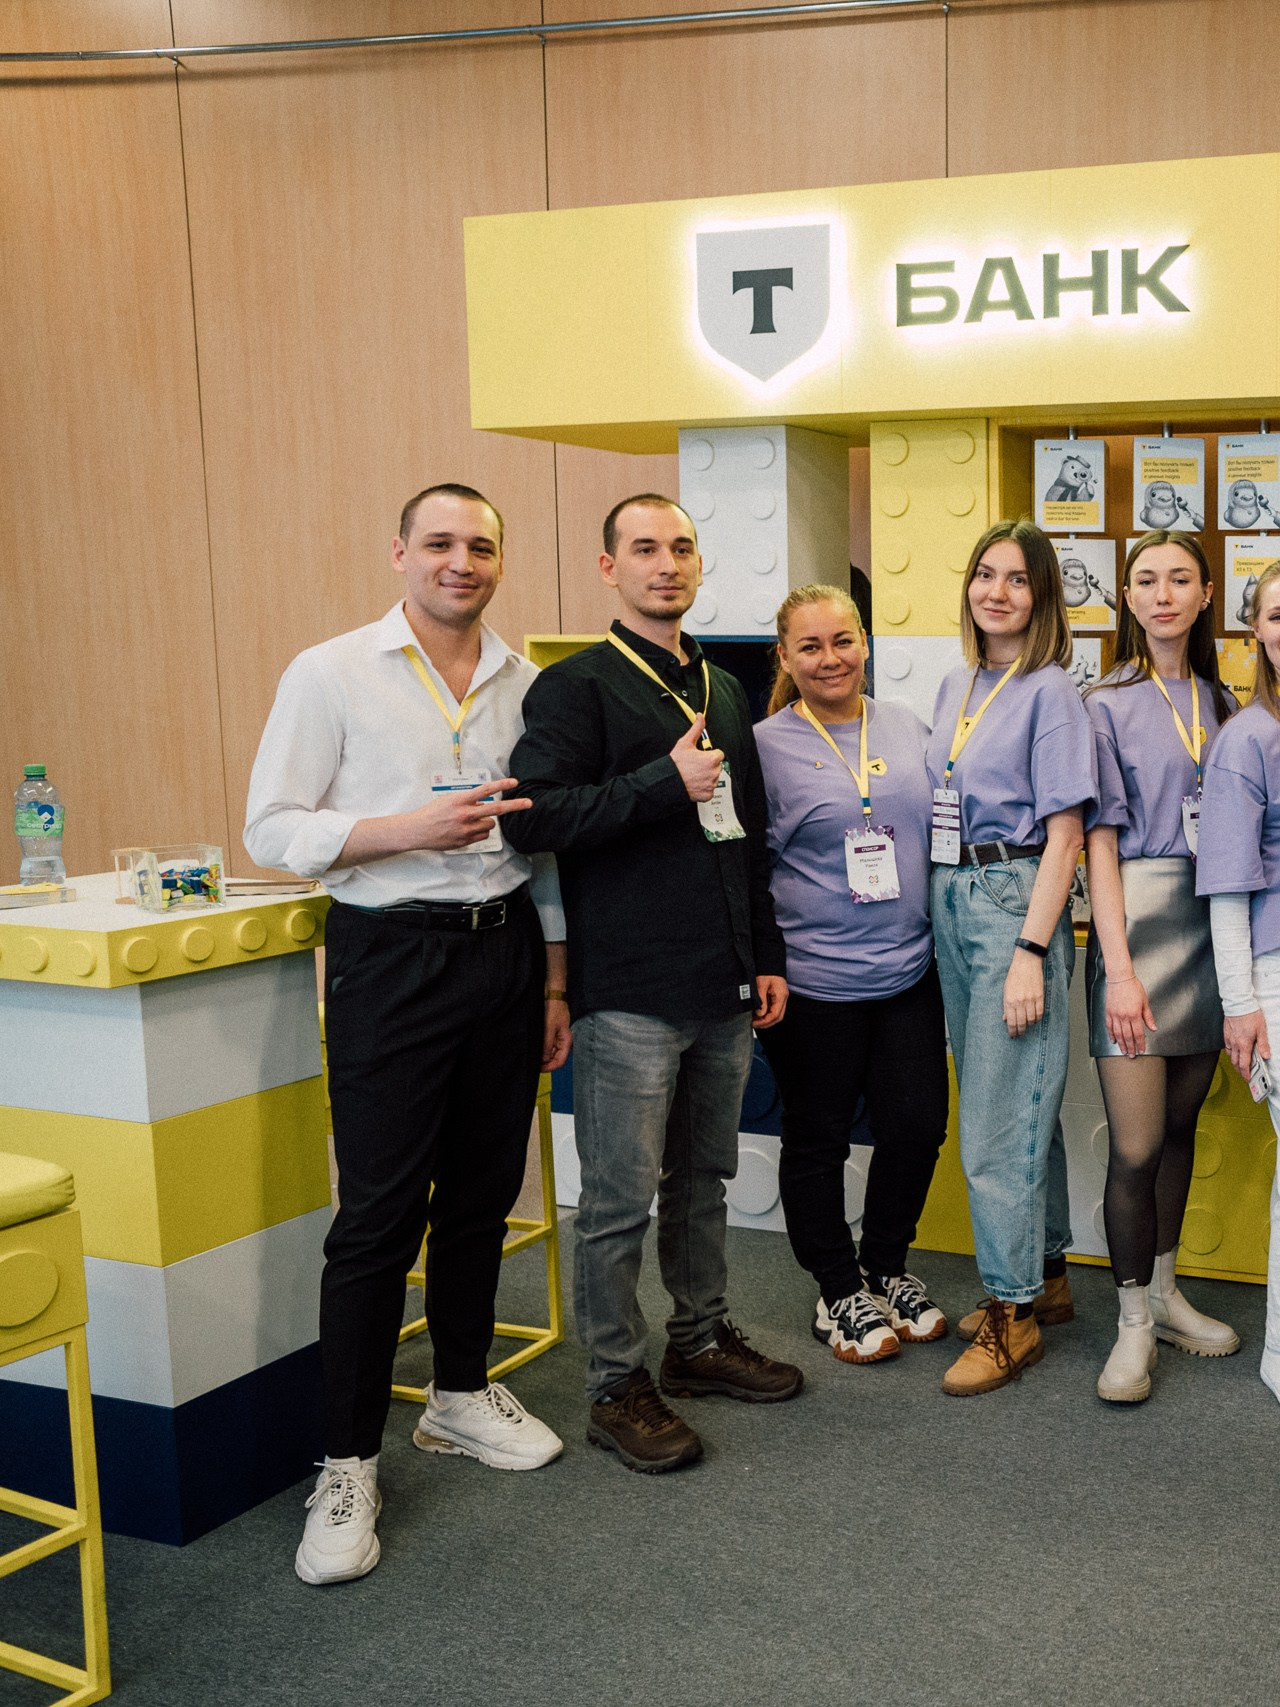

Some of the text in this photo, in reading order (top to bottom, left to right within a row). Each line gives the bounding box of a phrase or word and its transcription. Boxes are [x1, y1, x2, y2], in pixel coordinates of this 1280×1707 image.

[732, 244, 1191, 334] Т БАНК
[1233, 685, 1252, 693] БАНК
